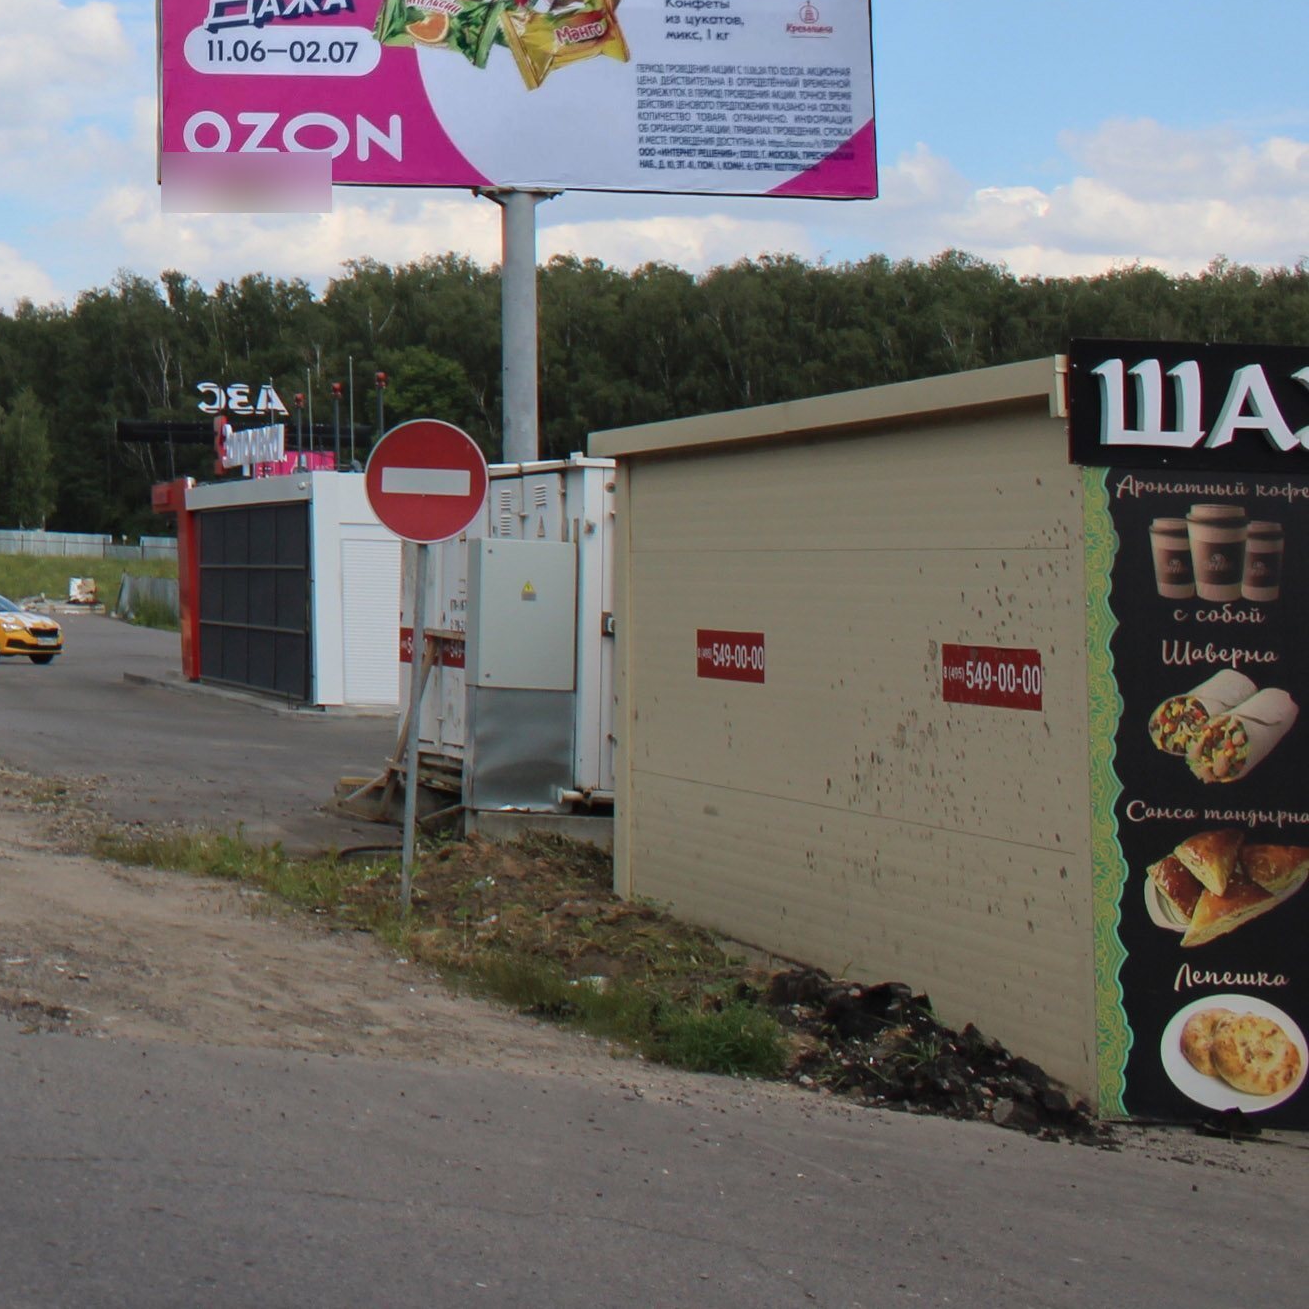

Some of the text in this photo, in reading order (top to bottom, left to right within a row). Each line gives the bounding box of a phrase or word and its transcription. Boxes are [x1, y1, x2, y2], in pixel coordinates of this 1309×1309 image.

[555, 21, 604, 44] Манго
[665, 14, 745, 27] из цукатов,
[665, 29, 703, 42] микс,
[716, 30, 731, 41] кг
[183, 110, 403, 162] OZON
[1116, 474, 1309, 503] Ароматный кофе
[1173, 602, 1266, 623] с собой
[712, 642, 764, 670] 549-00-00
[1161, 639, 1279, 668] Шаверма
[965, 660, 1041, 695] 549-00-00
[1126, 799, 1197, 822] Самса
[1173, 962, 1291, 992] Лепешка
